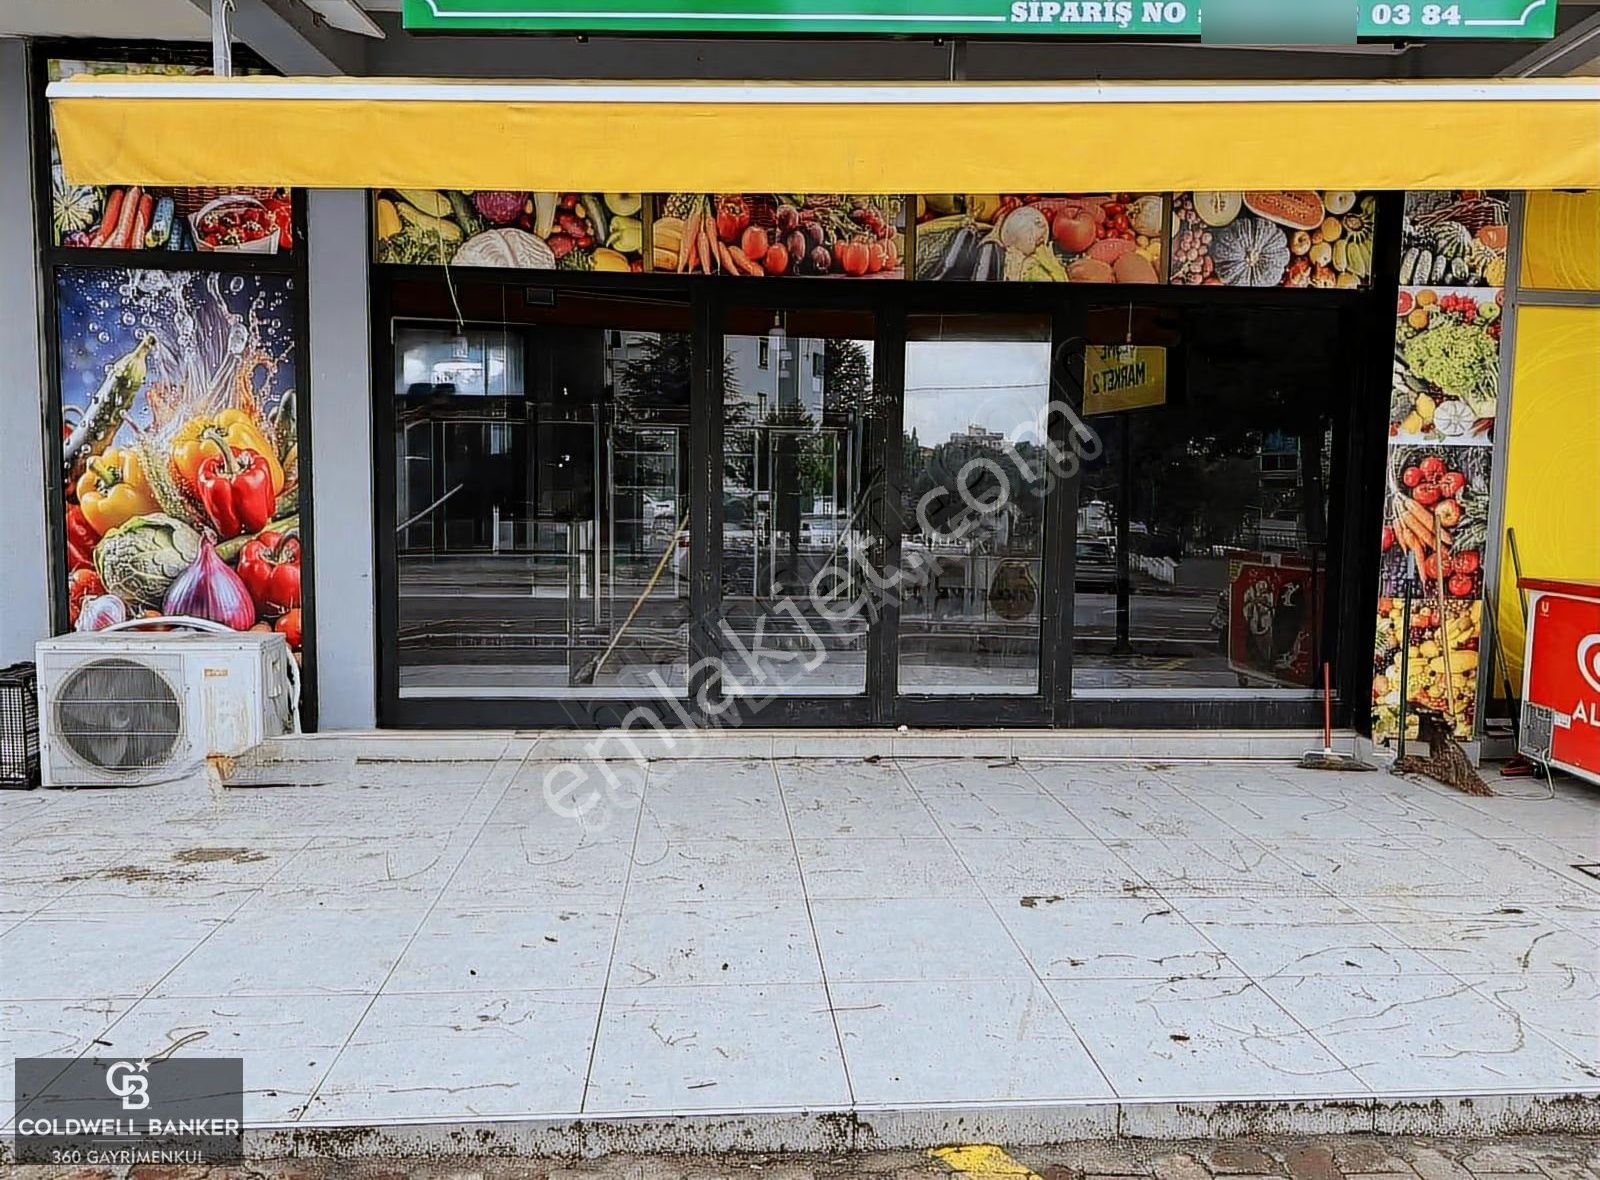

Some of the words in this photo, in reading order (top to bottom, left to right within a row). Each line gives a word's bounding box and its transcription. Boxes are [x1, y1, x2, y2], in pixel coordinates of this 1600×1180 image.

[1011, 0, 1132, 28] SİPARİŞ
[1142, 2, 1186, 23] NO
[1372, 4, 1410, 25] 03
[1422, 4, 1461, 26] 84
